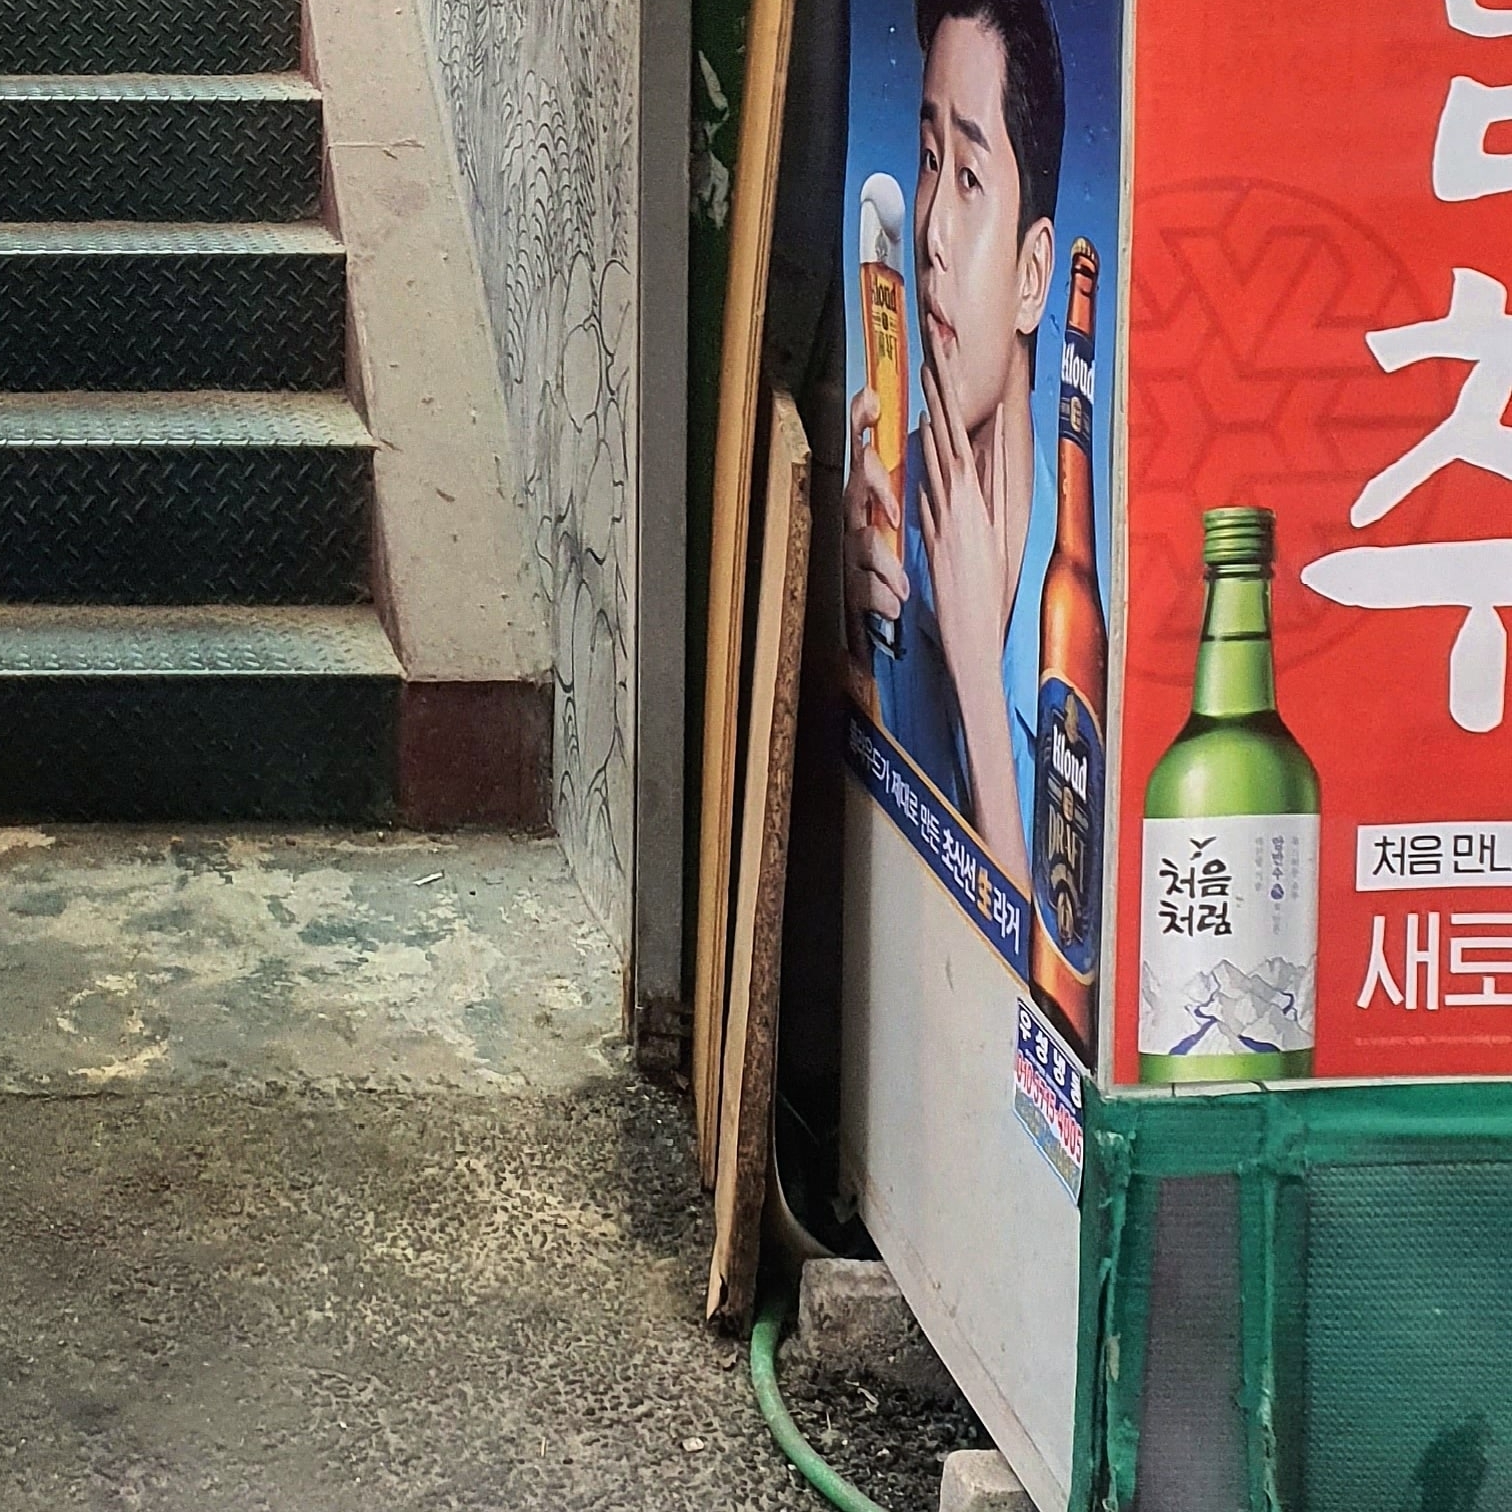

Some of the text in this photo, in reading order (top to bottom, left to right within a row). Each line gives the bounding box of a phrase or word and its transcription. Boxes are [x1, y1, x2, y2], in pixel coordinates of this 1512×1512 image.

[1373, 834, 1443, 876] 처음
[1159, 857, 1233, 899] 처음
[1157, 899, 1233, 937] 처럼
